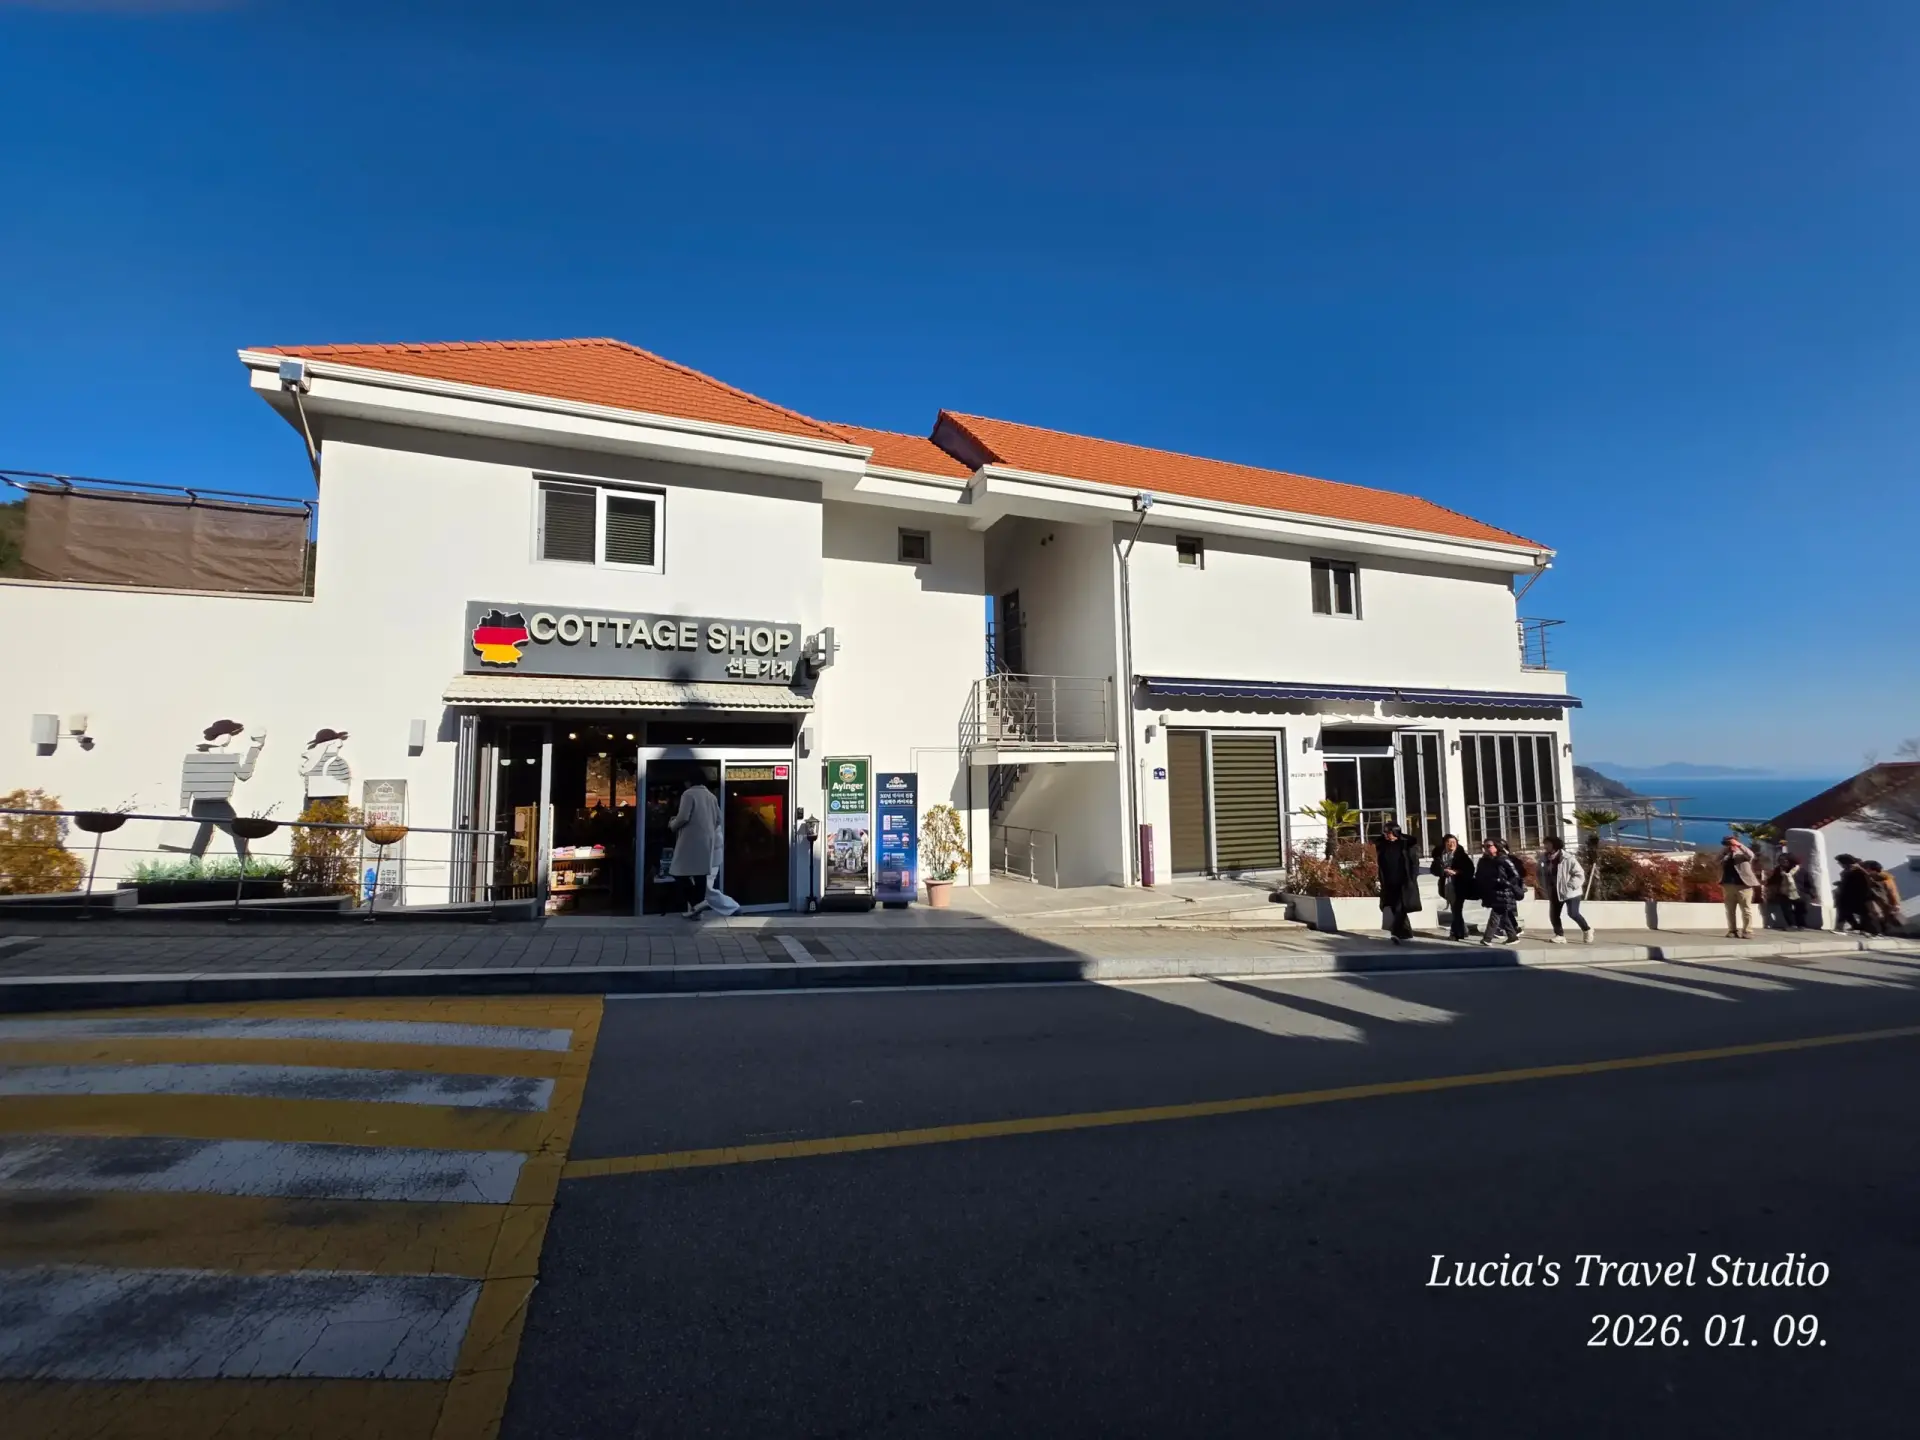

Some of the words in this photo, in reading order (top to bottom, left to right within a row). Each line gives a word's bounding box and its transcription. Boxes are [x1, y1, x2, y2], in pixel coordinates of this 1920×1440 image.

[530, 612, 699, 648] COTTAGE
[708, 623, 794, 653] SHOP
[727, 657, 793, 678] 선물가게
[832, 782, 864, 792] Ayinger
